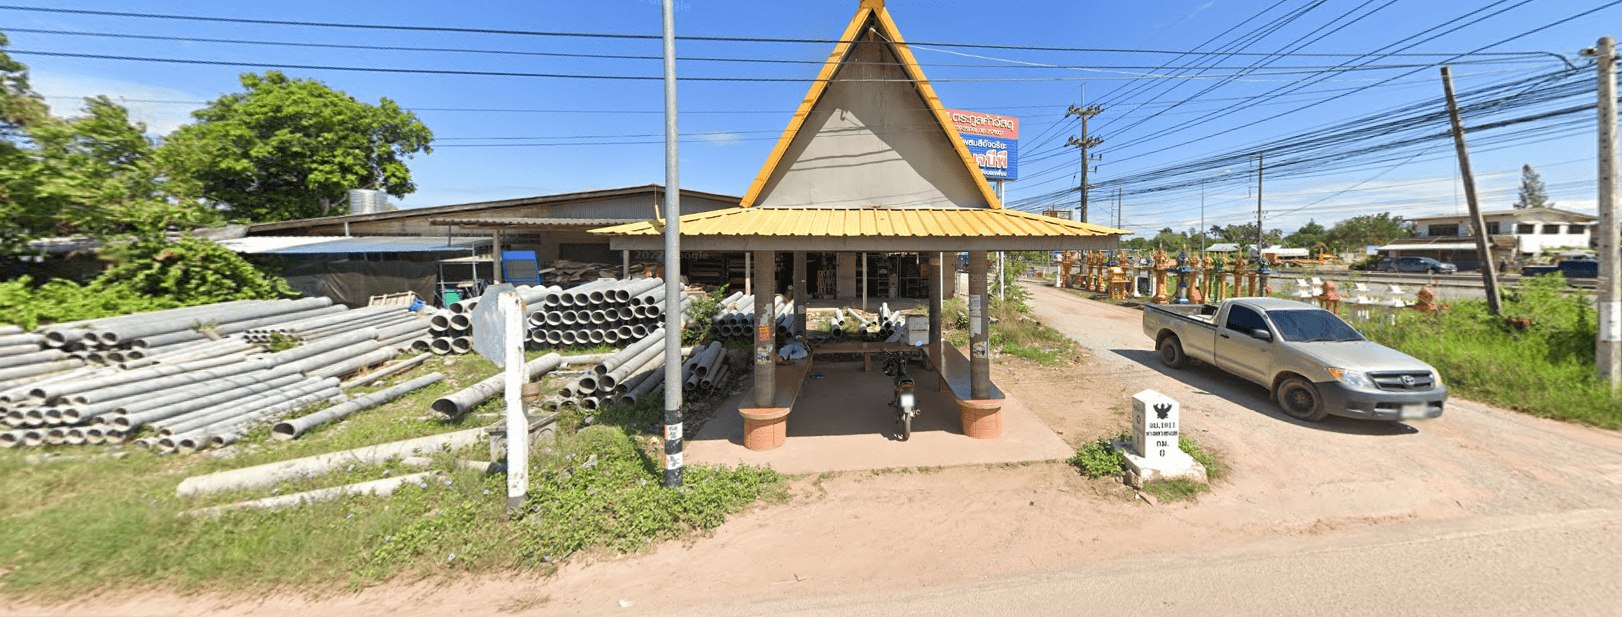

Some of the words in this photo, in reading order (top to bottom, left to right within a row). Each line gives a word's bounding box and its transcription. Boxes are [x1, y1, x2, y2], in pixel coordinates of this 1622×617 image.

[947, 112, 1014, 131] .ตระกูลค้าวัสดุ
[1159, 449, 1165, 457] 0
